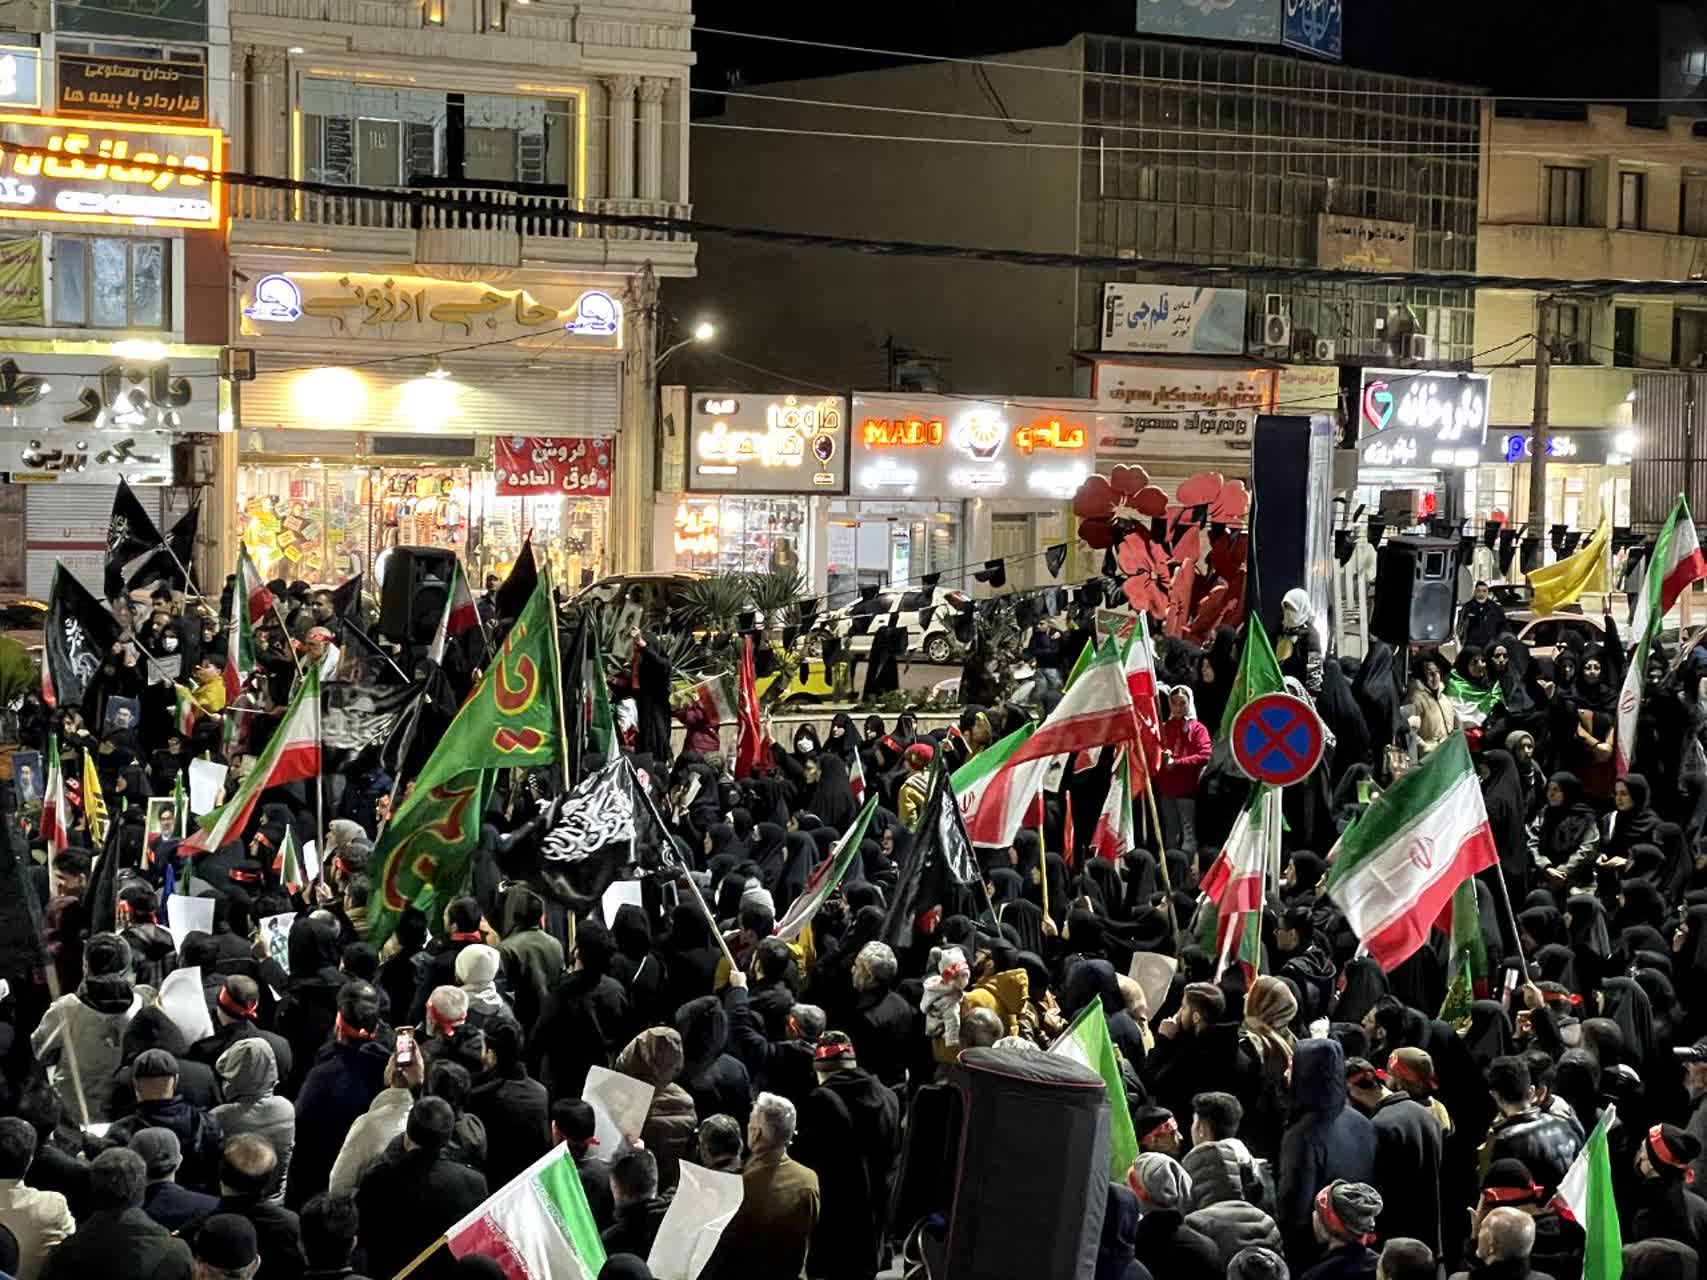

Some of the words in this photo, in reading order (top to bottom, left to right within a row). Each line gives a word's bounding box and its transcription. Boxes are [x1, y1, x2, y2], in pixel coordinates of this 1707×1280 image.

[84, 63, 143, 80] مصنوعی
[142, 66, 179, 82] دندان
[63, 86, 85, 103] ها
[88, 90, 124, 110] بیمه
[126, 90, 139, 110] با
[143, 92, 200, 112] قرارداد
[302, 276, 426, 332] ارزونی
[1397, 382, 1484, 440] داروخانه
[1122, 415, 1179, 434] مسعود
[532, 438, 586, 466] فروش
[508, 469, 555, 488] العاده
[562, 469, 600, 491] فوق
